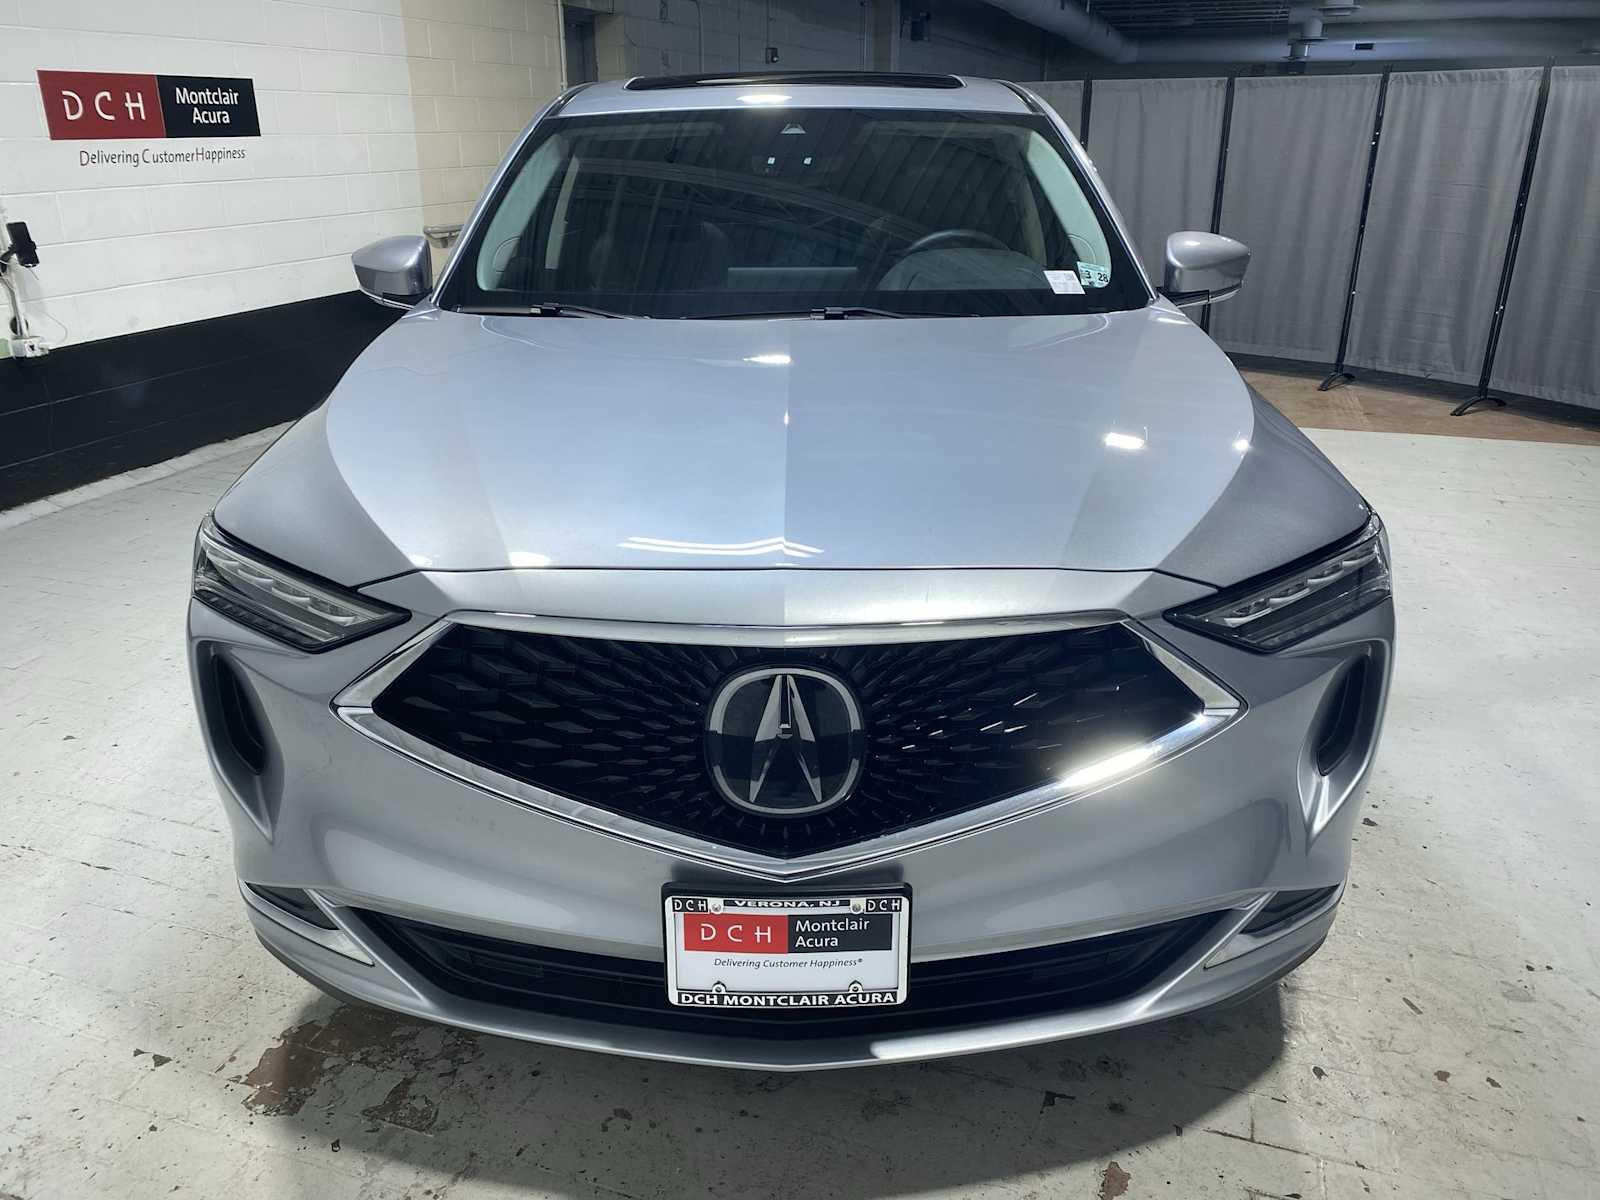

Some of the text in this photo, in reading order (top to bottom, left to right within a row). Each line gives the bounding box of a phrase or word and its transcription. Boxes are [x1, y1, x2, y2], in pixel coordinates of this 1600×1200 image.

[175, 87, 239, 105] Montclair
[61, 90, 146, 121] DCH
[192, 107, 230, 124] Acura
[79, 150, 139, 167] Delivering
[674, 900, 707, 911] DCH
[868, 900, 900, 911] DCH
[796, 919, 870, 933] Montclair
[701, 924, 772, 943] DCH
[795, 936, 839, 948] Acura
[714, 958, 760, 968] Delivering
[763, 960, 807, 968] Customer
[681, 993, 895, 1006] DCH MONTCLAIR ACURA
